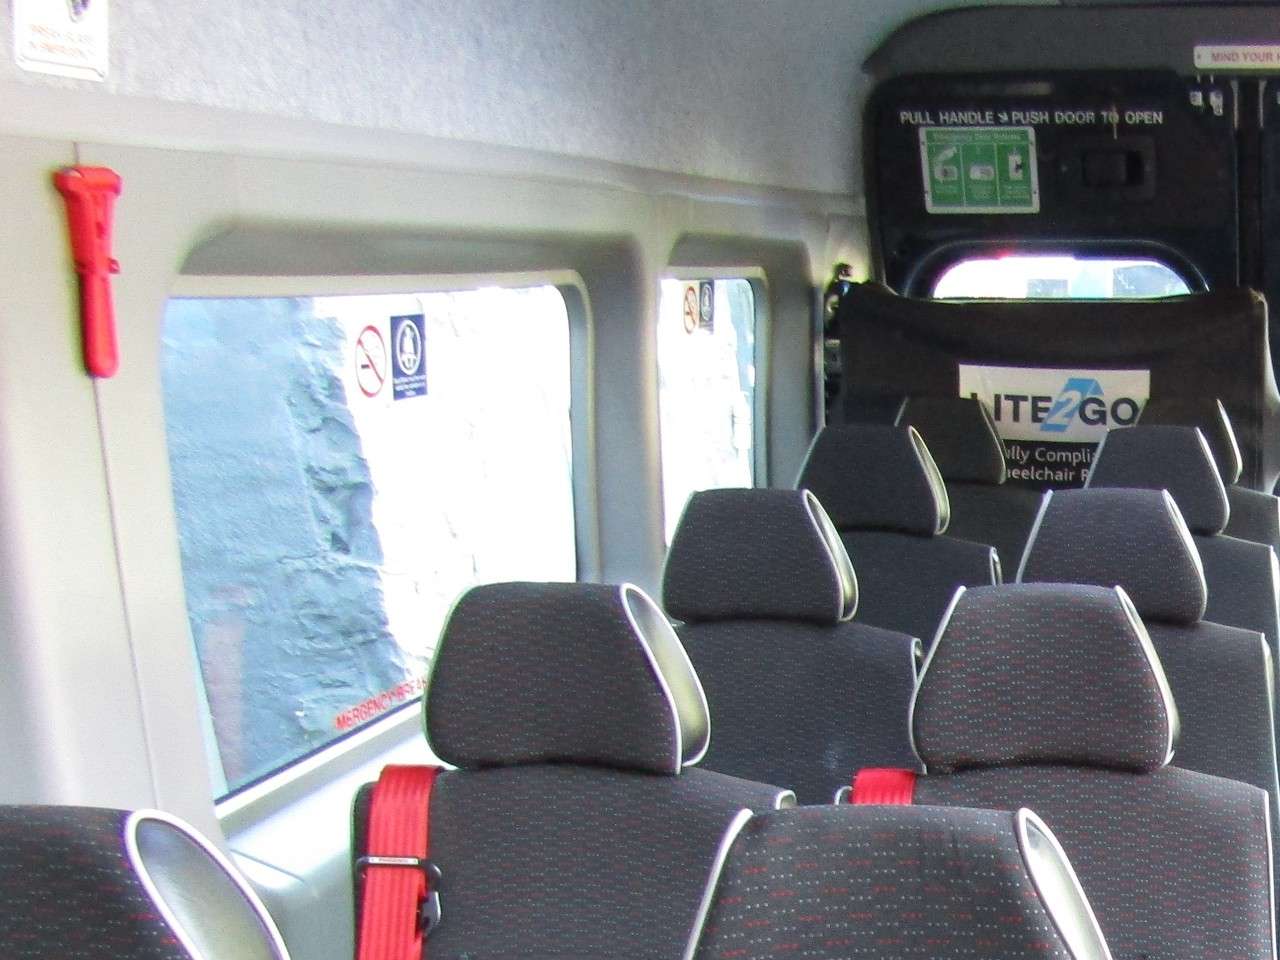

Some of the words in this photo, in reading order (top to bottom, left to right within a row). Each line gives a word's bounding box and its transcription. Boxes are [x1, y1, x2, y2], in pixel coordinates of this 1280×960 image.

[1211, 52, 1240, 62] MIND
[1242, 52, 1274, 62] YOUR
[900, 111, 935, 125] PULL
[939, 111, 994, 125] HANDLE
[1011, 111, 1049, 125] PUSH
[1054, 111, 1096, 125] DOOR
[1100, 111, 1119, 125] TO
[1125, 111, 1163, 125] OPEN
[971, 379, 1138, 431] ITE2GO
[1035, 447, 1098, 467] Compli
